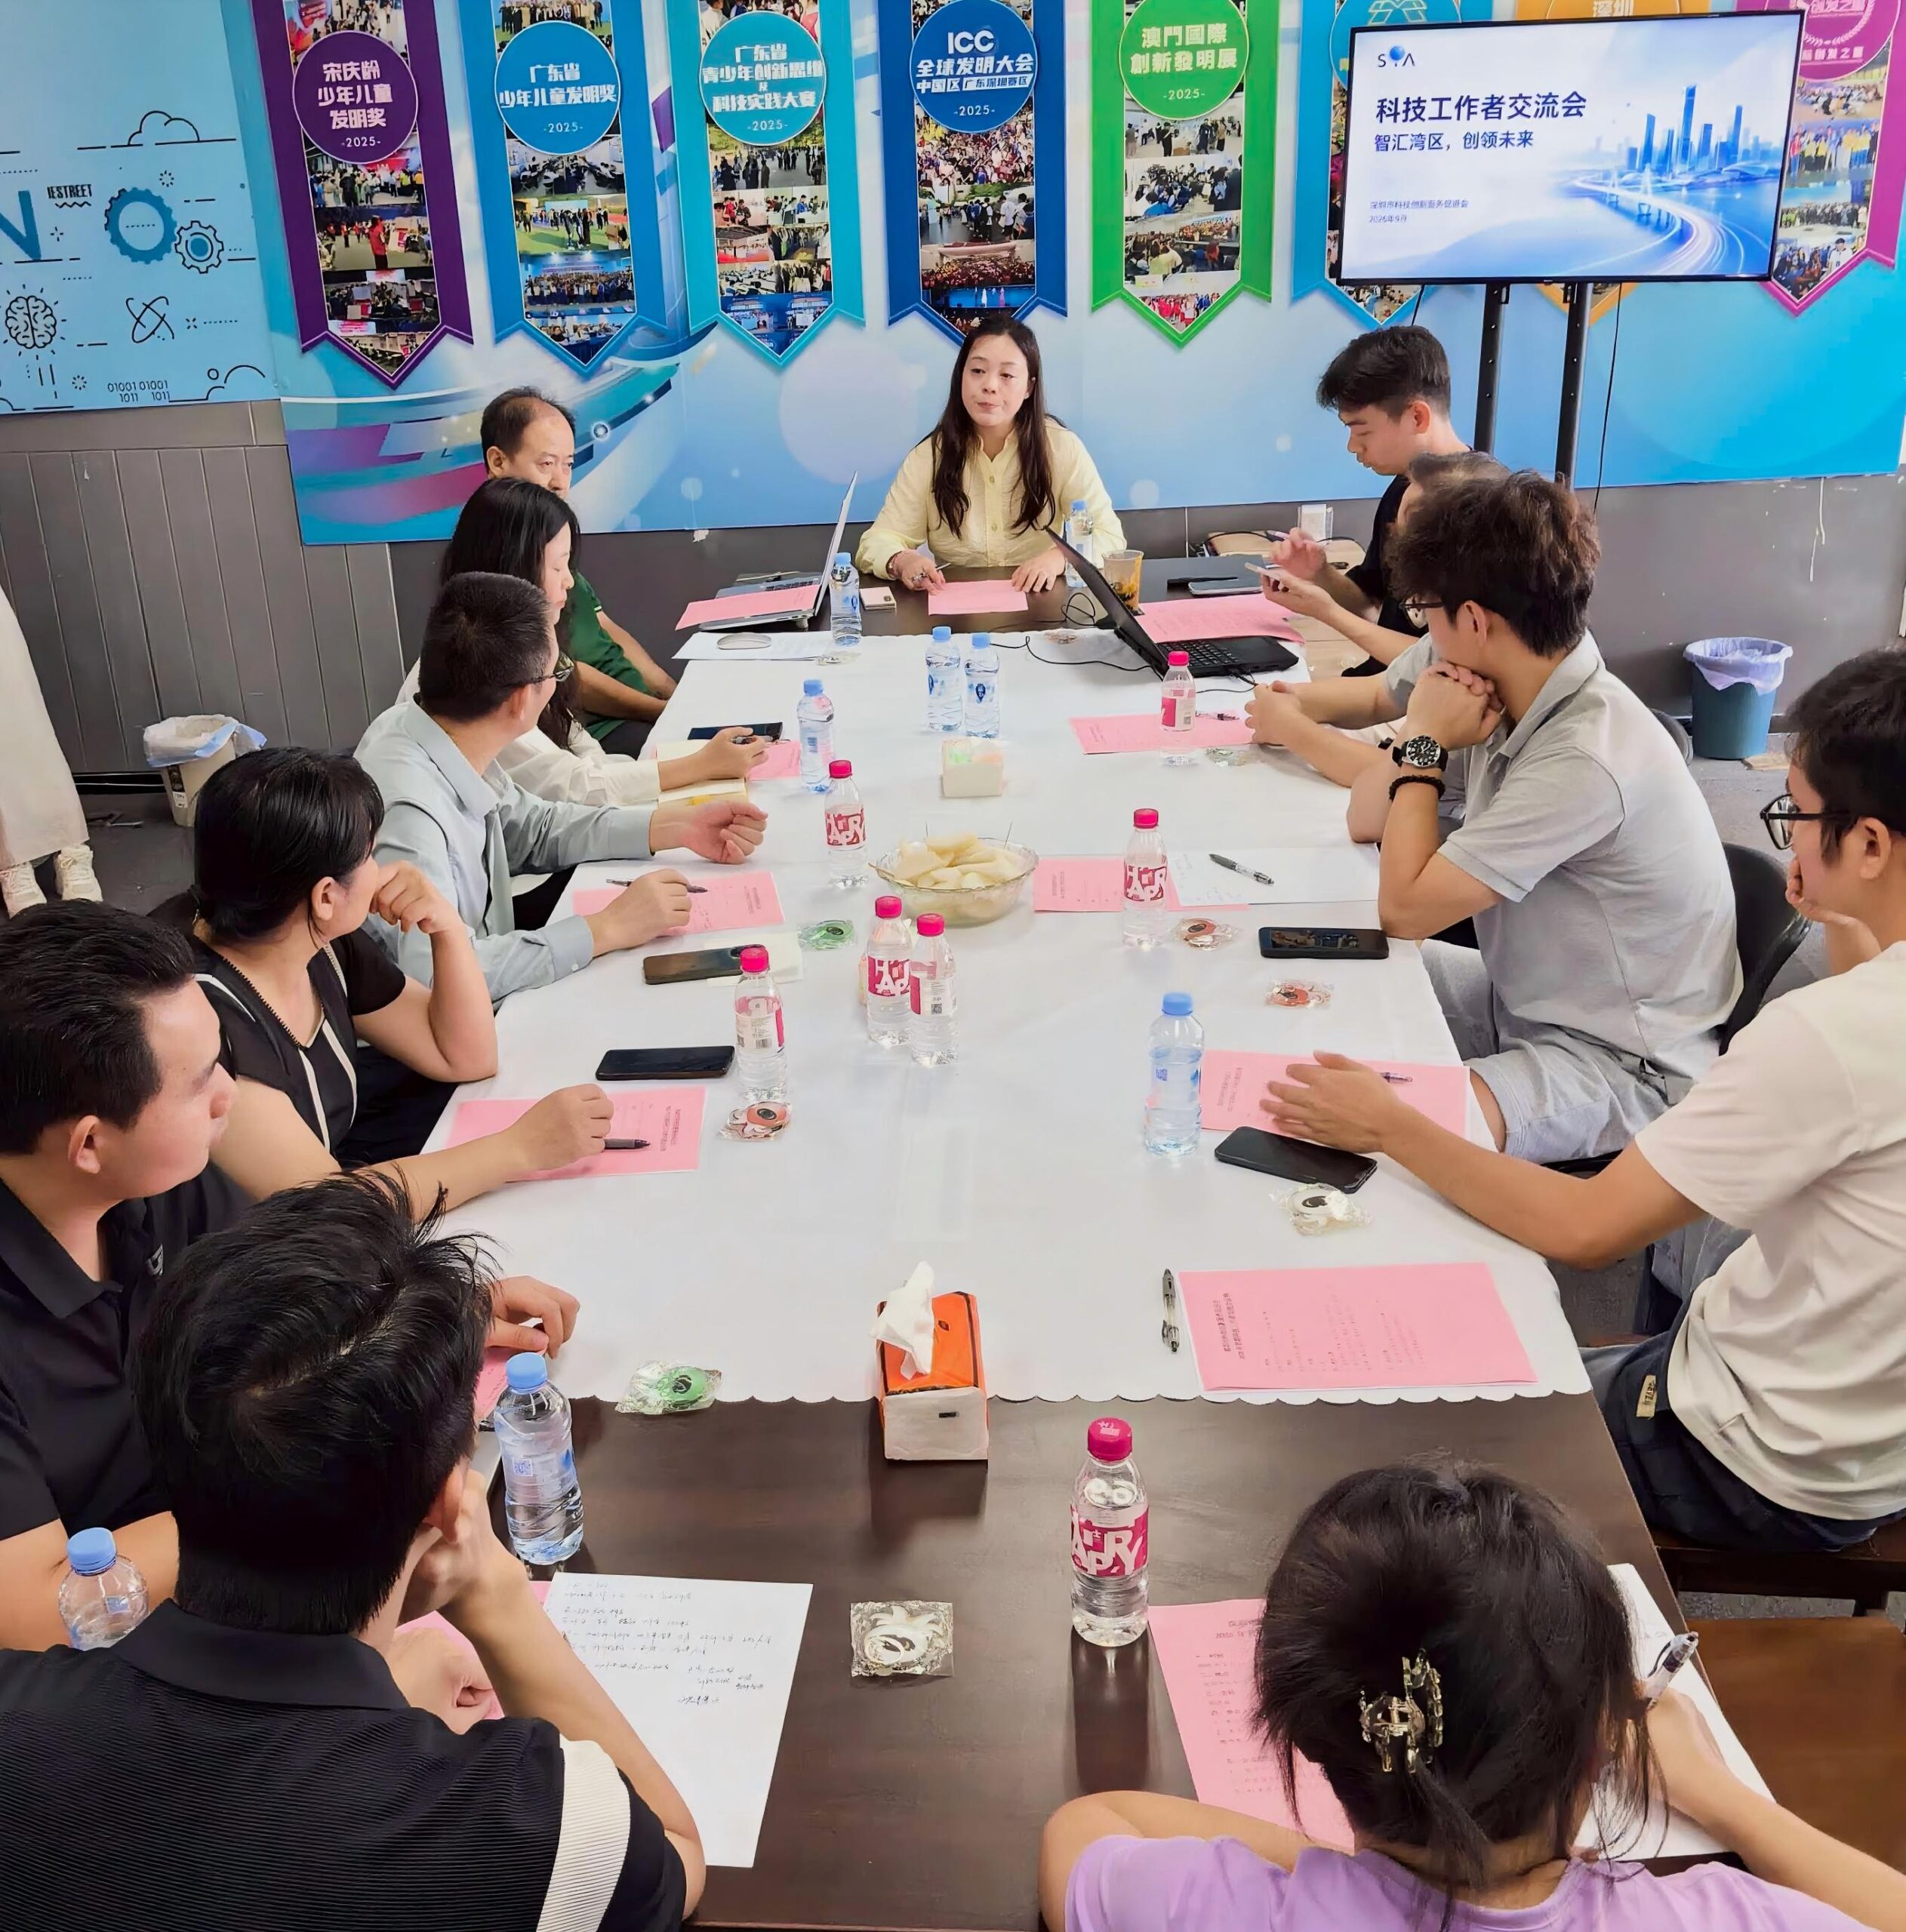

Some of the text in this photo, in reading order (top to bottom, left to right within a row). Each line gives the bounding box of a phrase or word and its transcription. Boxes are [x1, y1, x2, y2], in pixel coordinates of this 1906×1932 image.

[947, 29, 995, 54] ICC
[1141, 23, 1227, 49] 澳門國際
[734, 43, 787, 63] 广东省
[1130, 48, 1237, 75] 創新發明展
[322, 60, 380, 82] 宋庆龄
[529, 63, 580, 83] 广东省
[702, 60, 824, 84] 青少年创新思维
[916, 53, 1034, 78] 全球发明大会
[318, 83, 393, 106] 少年儿童
[499, 84, 617, 109] 少年儿童发明奖
[916, 78, 961, 94] 中国区
[712, 91, 817, 113] 科技实践大赛
[1375, 91, 1587, 124] 科技工作者交流会
[329, 107, 386, 130] 发明奖
